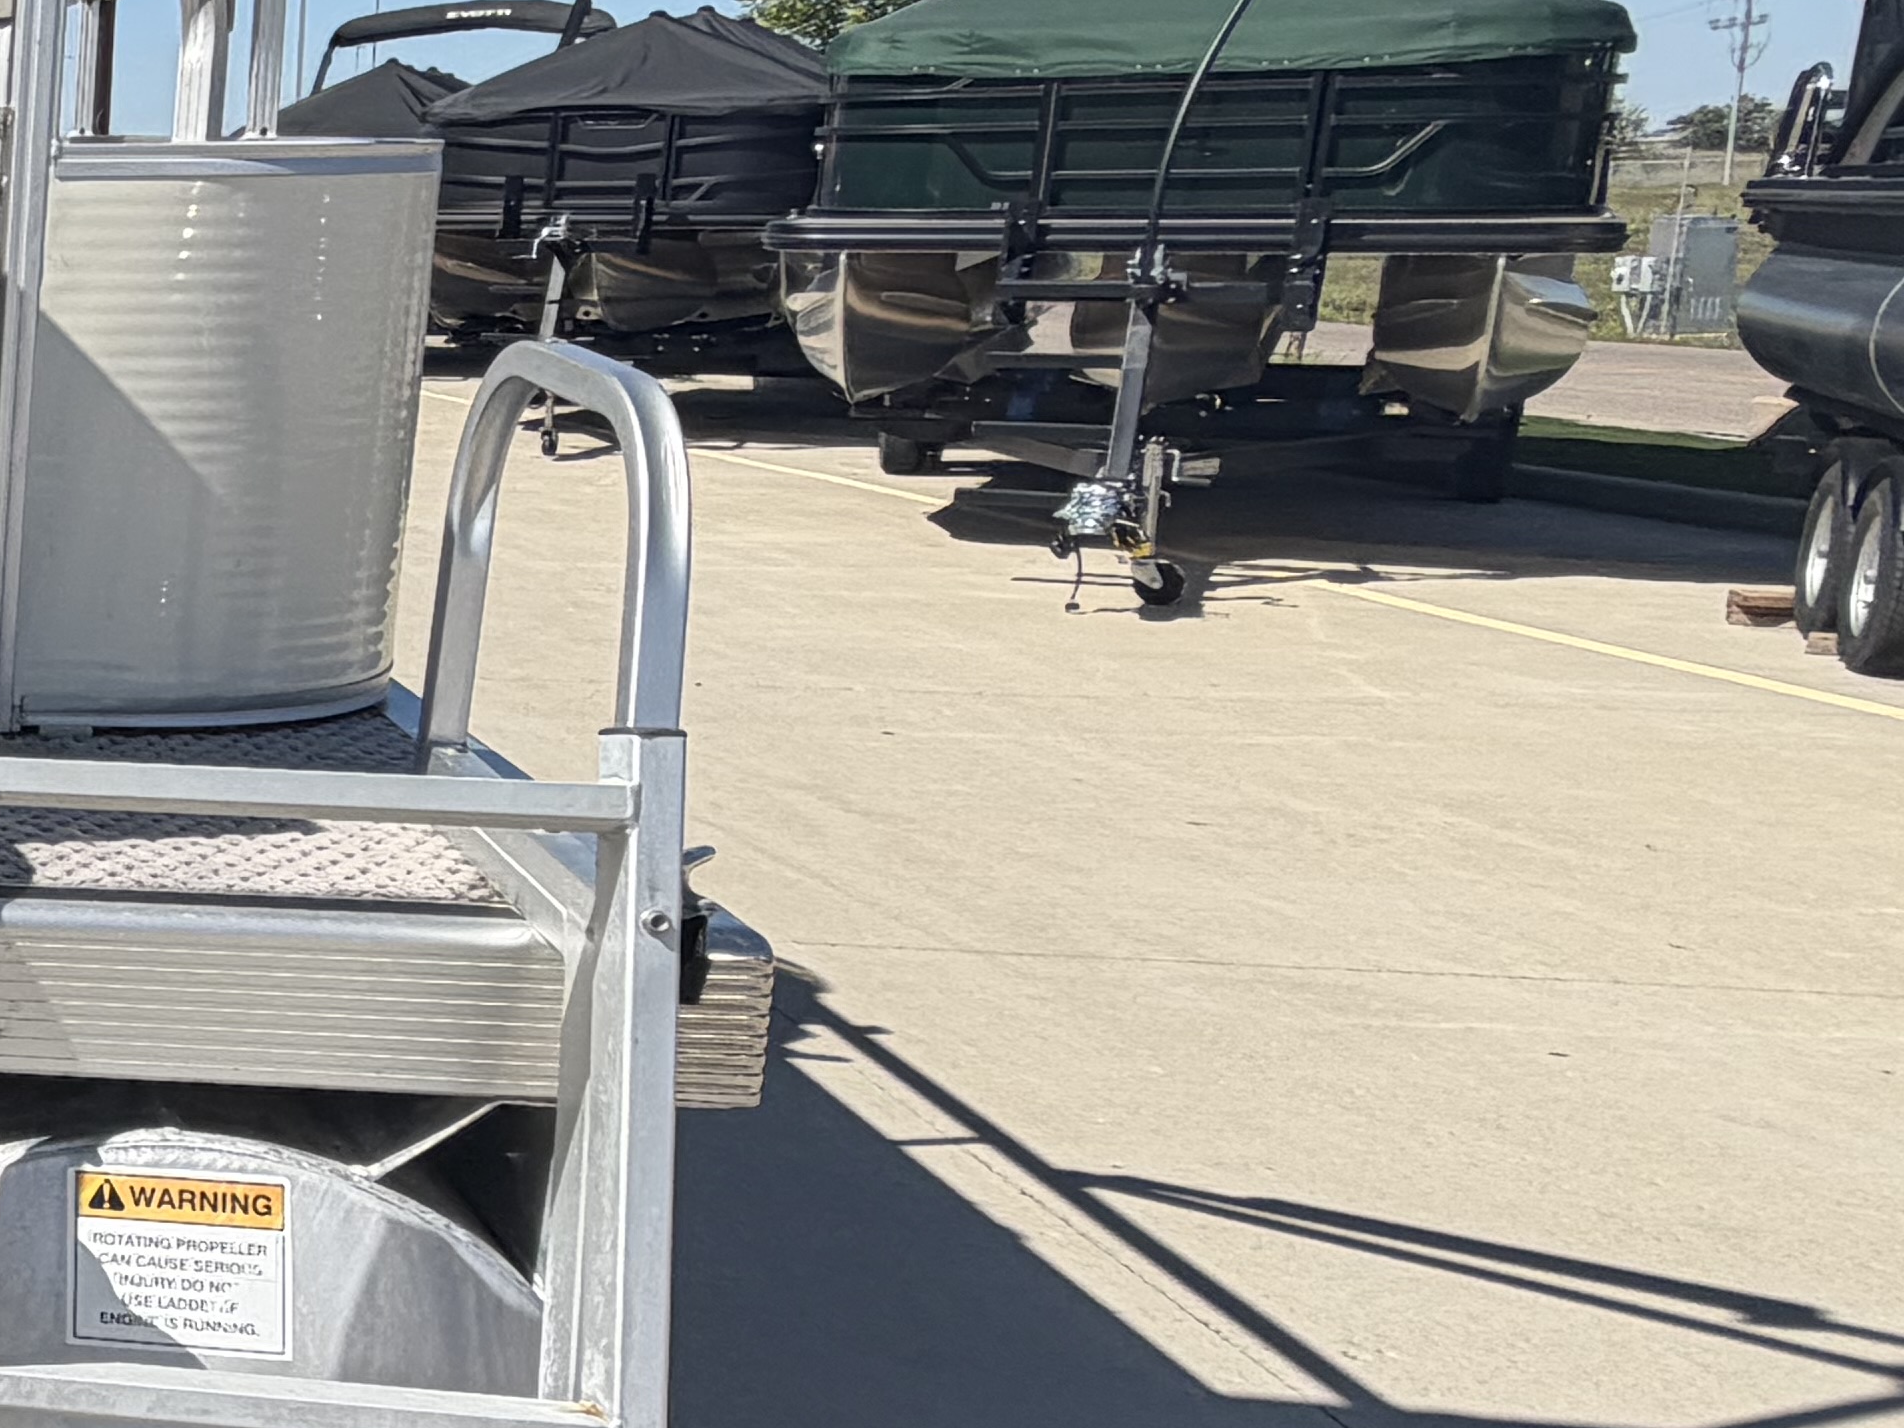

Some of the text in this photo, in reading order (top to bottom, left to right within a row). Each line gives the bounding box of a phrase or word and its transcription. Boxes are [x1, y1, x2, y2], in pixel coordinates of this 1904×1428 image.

[128, 1185, 273, 1217] WARNING
[92, 1231, 268, 1256] ROTATING PROPELLER
[98, 1252, 132, 1266] CAN
[135, 1254, 190, 1271] CAUSE
[181, 1278, 204, 1292] DO
[209, 1280, 240, 1293] NO
